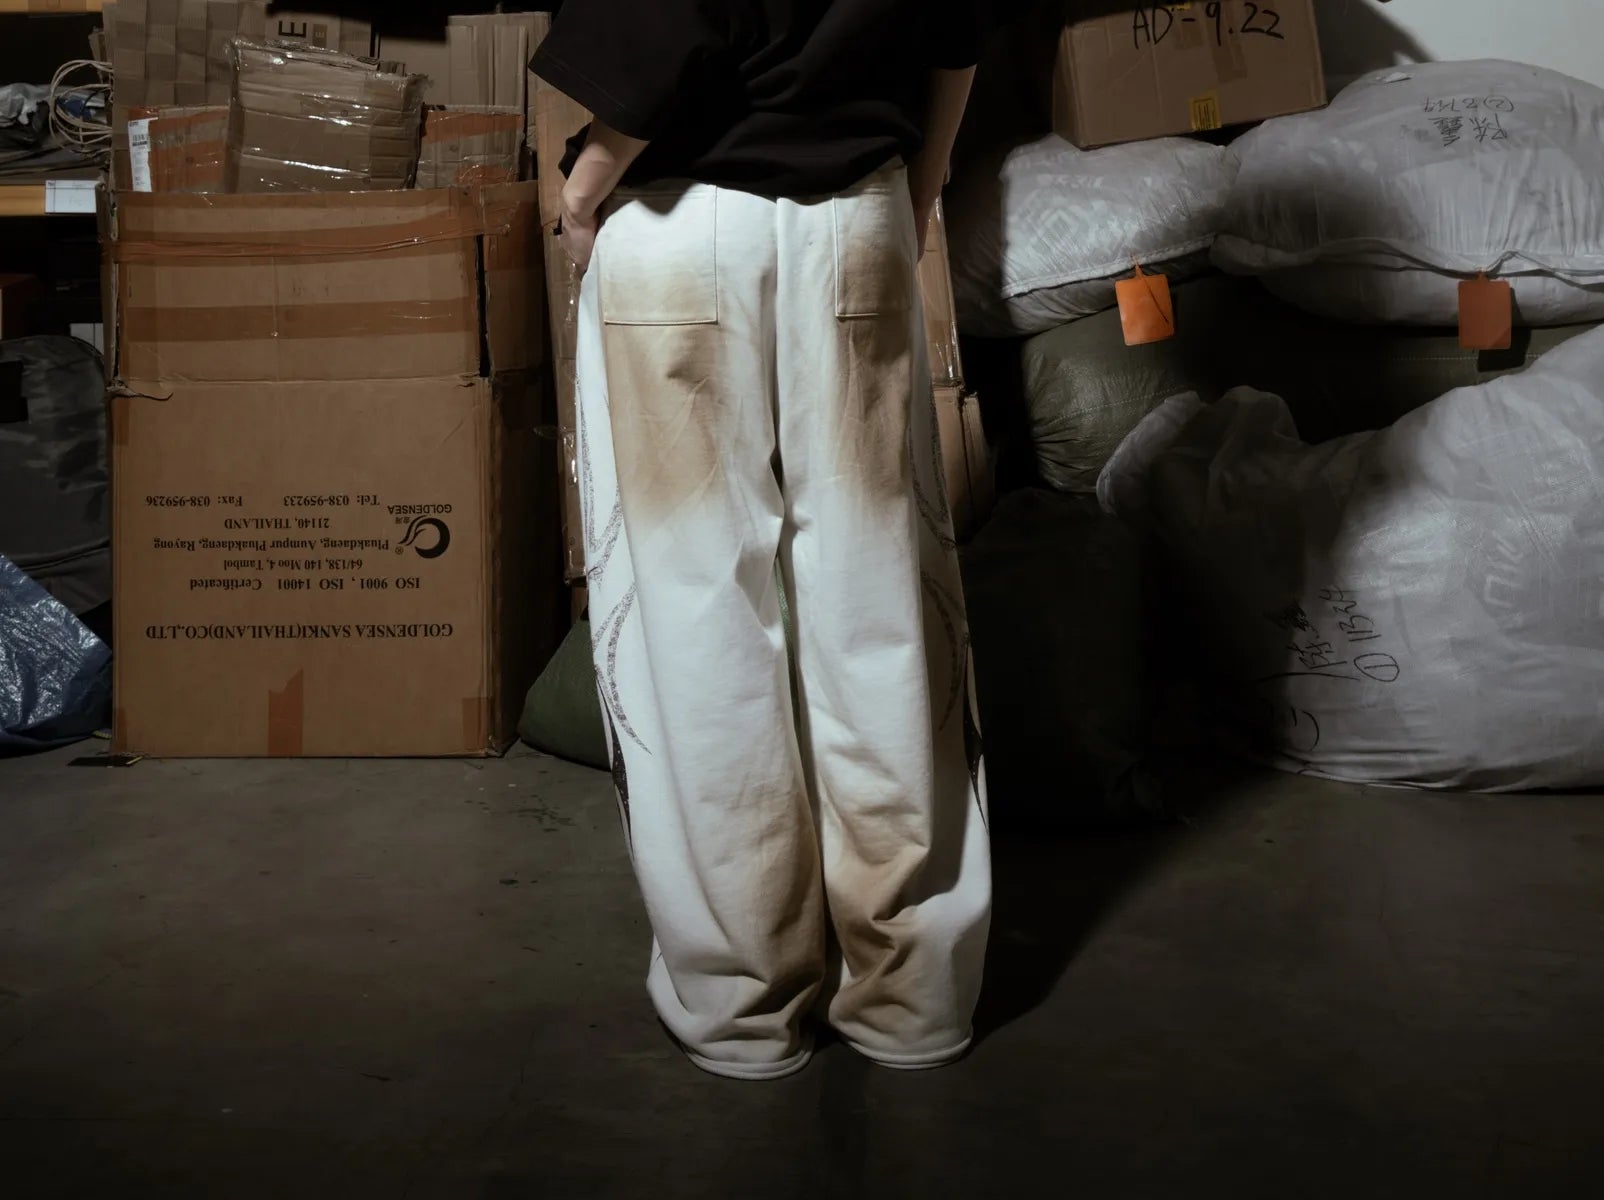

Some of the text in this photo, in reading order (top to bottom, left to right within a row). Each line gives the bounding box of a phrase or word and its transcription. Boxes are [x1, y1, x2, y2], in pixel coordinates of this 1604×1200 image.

[146, 495, 379, 506] Tel: 038-959233 Fax: 038-959236
[387, 504, 452, 513] GOLDENSEA
[224, 517, 330, 529] 21140, THAILAND
[153, 537, 389, 551] Pluakdaeng, Aumpur Pluakdaeng, Rayong
[224, 558, 363, 570] 64/138, 140 Moo 4, Tambol
[190, 578, 262, 590] Certificated
[277, 578, 311, 590] 14001
[319, 578, 344, 589] ISO
[396, 578, 420, 589] ISO
[359, 623, 453, 638] GOLDENSEA
